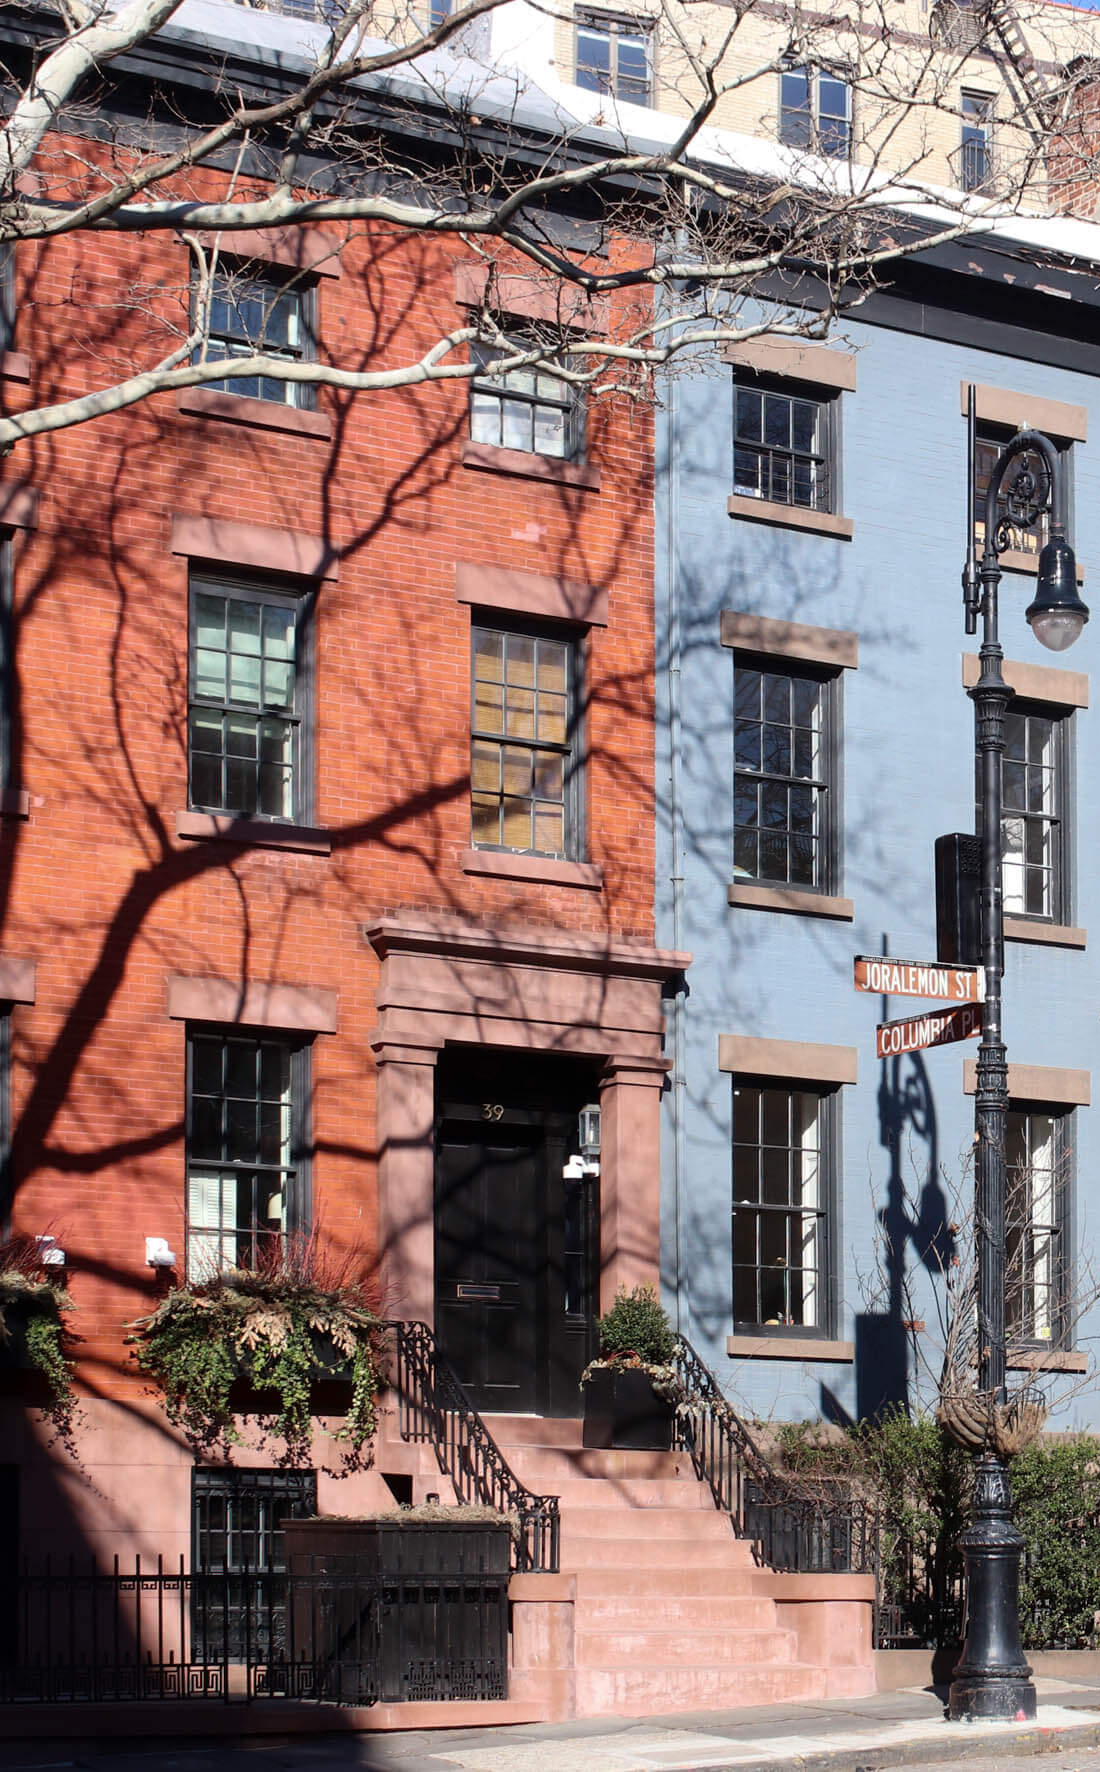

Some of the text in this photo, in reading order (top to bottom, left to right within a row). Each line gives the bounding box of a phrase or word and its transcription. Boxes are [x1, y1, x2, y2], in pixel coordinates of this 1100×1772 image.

[862, 963, 973, 999] JORALEMON ST
[881, 1015, 955, 1054] COLUMBIA
[962, 1010, 980, 1036] PL
[481, 1103, 504, 1121] 39
